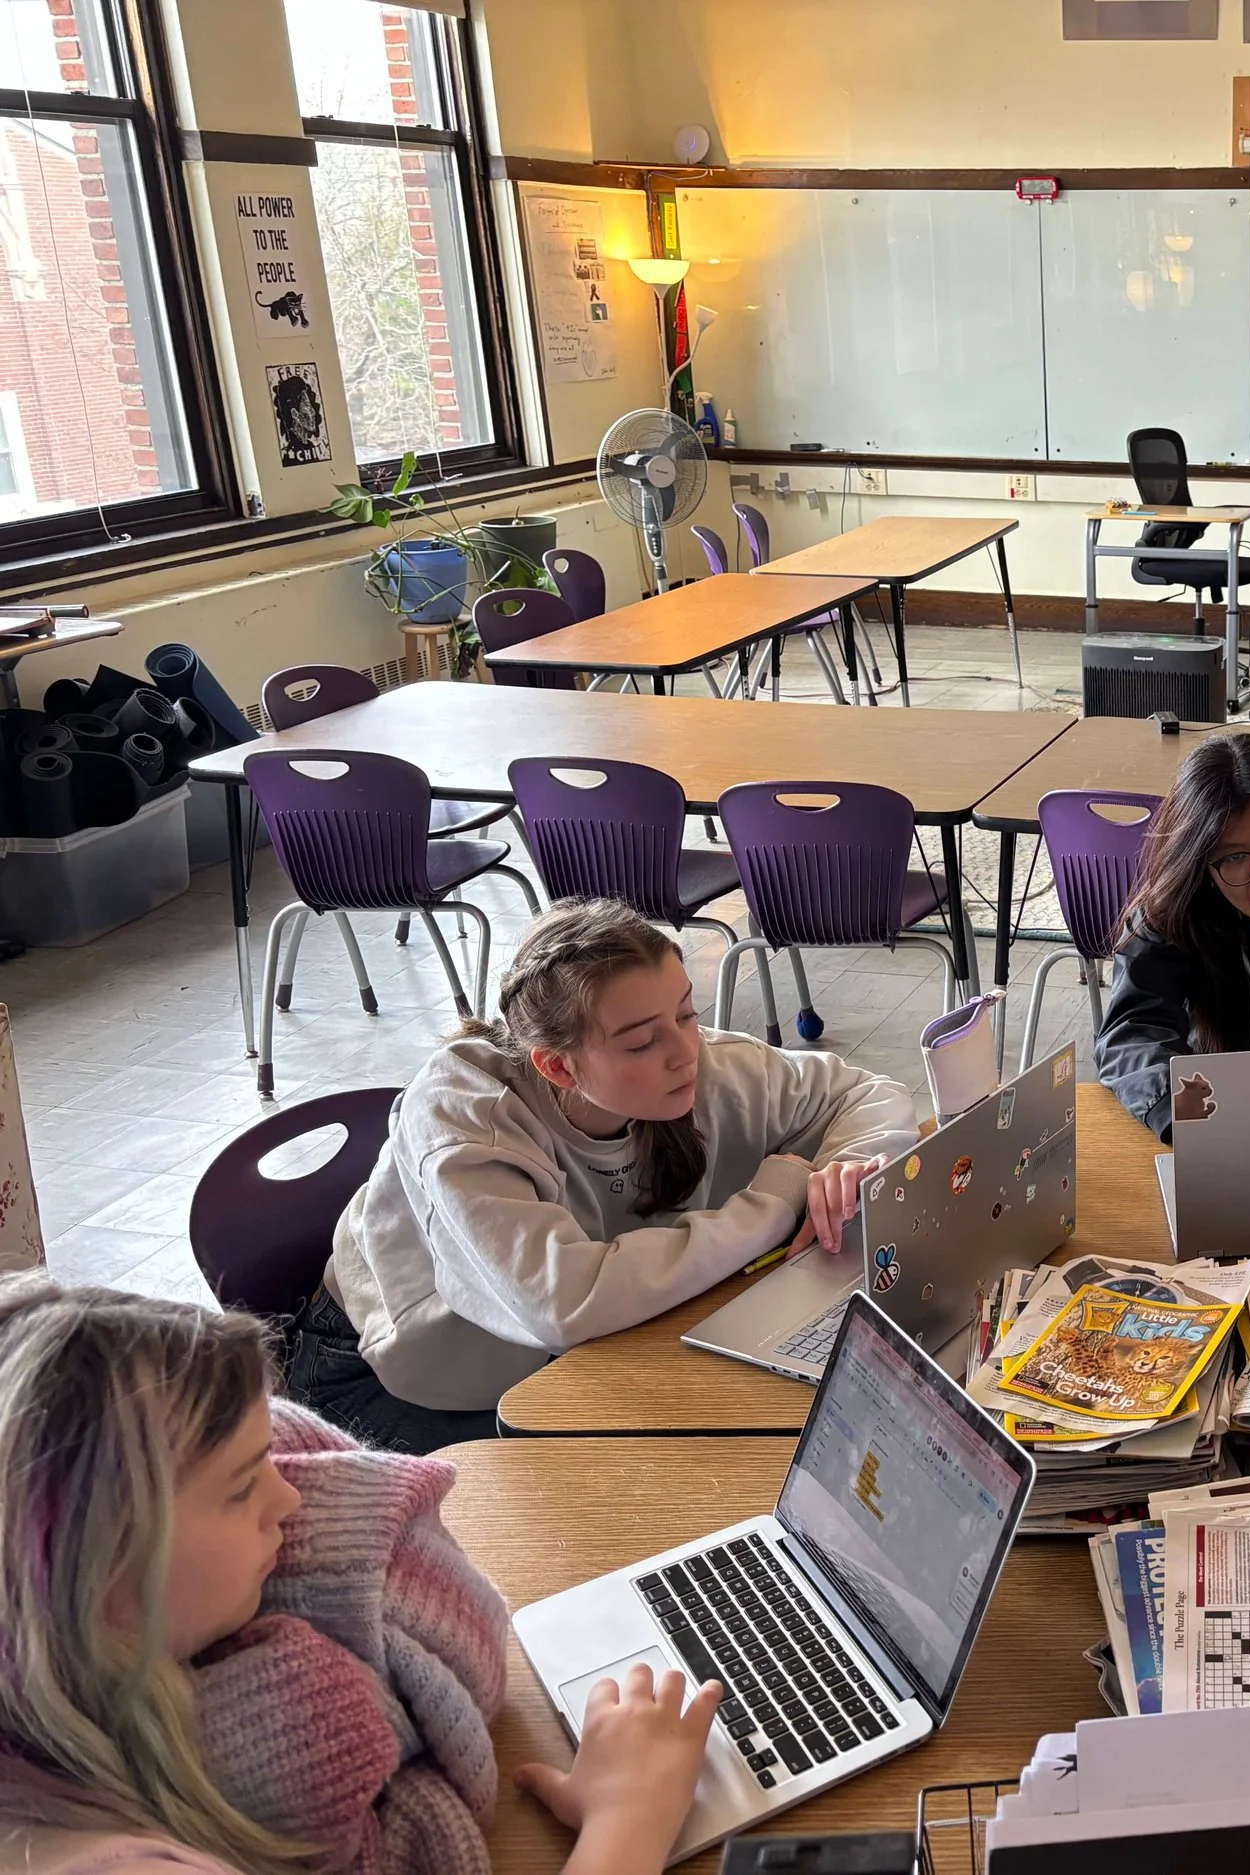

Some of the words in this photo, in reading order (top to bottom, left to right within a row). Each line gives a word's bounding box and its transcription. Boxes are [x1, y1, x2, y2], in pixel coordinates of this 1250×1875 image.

[238, 196, 257, 217] ALL
[258, 196, 295, 218] POWER
[253, 230, 267, 250] TO
[268, 230, 288, 250] THE
[257, 262, 296, 283] PEOPLE
[277, 366, 310, 381] FREE
[1142, 1312, 1178, 1324] Little
[1040, 1361, 1125, 1394] Cheetahs
[1056, 1382, 1108, 1404] Grow
[1109, 1394, 1136, 1410] Up
[1135, 1539, 1146, 1563] Possibly
[1139, 1564, 1147, 1574] the
[1140, 1575, 1150, 1597] biggest
[1175, 1591, 1186, 1608] Page
[1143, 1598, 1153, 1623] advance
[1174, 1610, 1184, 1632] Puzzle
[1150, 1640, 1159, 1650] the
[1174, 1634, 1184, 1650] The
[1152, 1652, 1161, 1674] double
